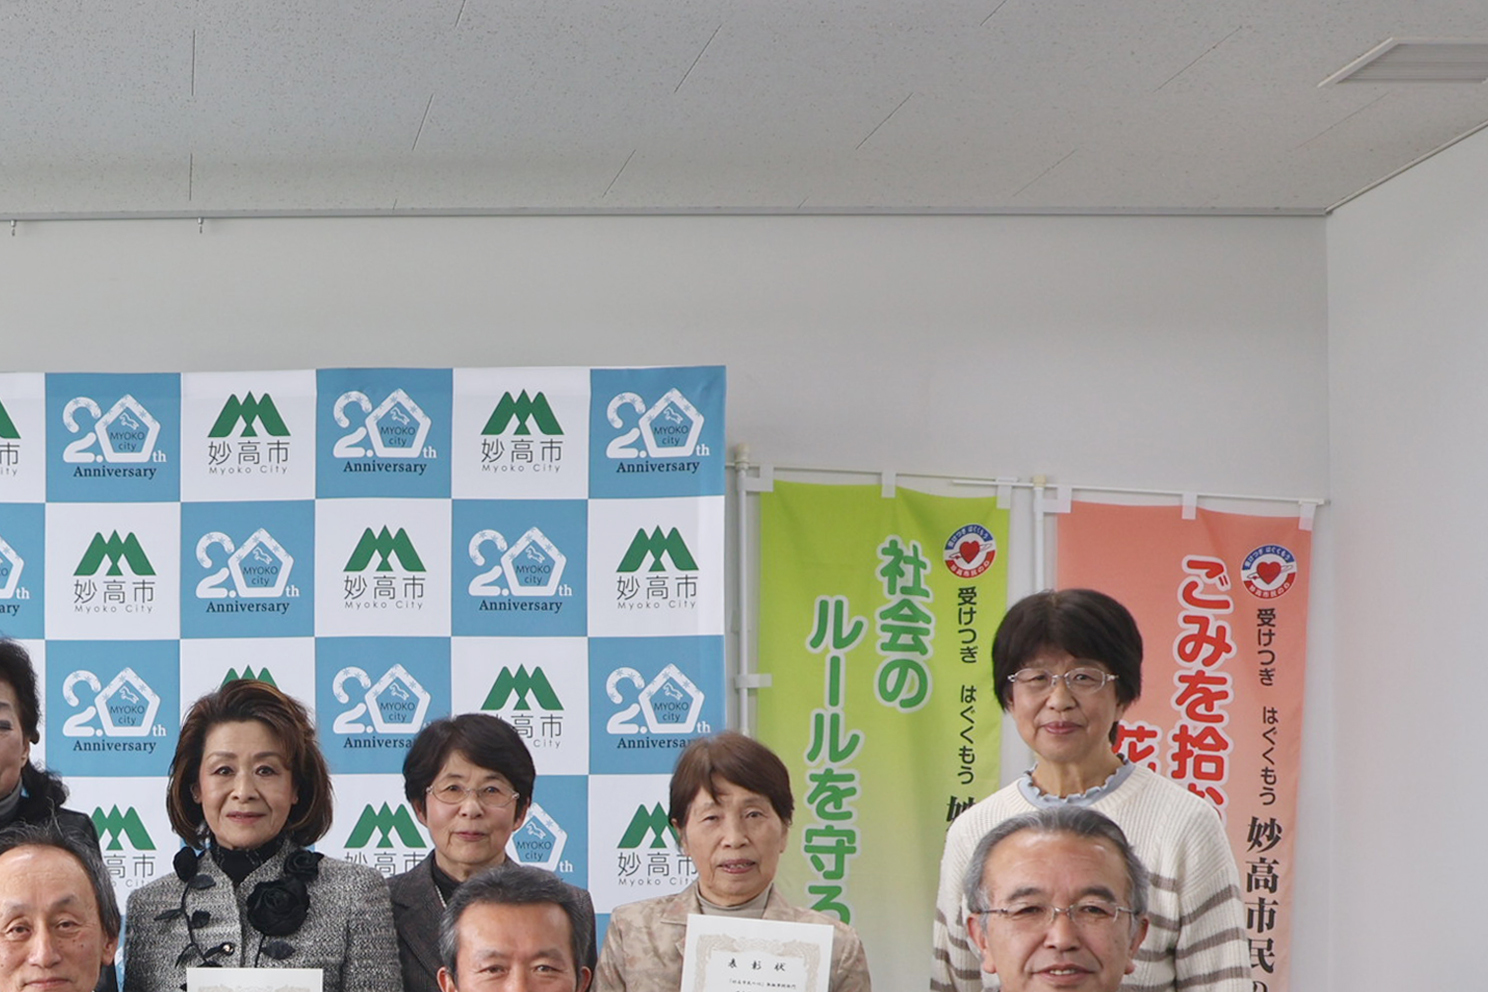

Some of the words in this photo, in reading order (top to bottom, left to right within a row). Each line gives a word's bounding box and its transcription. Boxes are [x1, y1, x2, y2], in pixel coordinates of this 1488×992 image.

[111, 431, 145, 440] MYOKO
[381, 426, 415, 435] MYOKO
[654, 426, 688, 435] MYOKO
[118, 441, 137, 451] city
[388, 436, 407, 446] city
[661, 436, 680, 446] city
[208, 440, 290, 465] 妙高市
[481, 438, 563, 463] 妙高市
[73, 464, 157, 480] Anniversary
[208, 465, 252, 475] Myoko
[259, 464, 288, 475] City
[343, 459, 427, 475] Anniversary
[481, 463, 525, 473] Myoko
[532, 462, 561, 473] City
[616, 459, 700, 475] Anniversary
[244, 566, 278, 575] MYOKO
[516, 564, 550, 573] MYOKO
[251, 576, 270, 586] city
[523, 574, 542, 584] city
[73, 579, 155, 604] 妙高市
[344, 575, 426, 600] 妙高市
[616, 575, 698, 600] 妙高市
[73, 604, 117, 614] Myoko
[124, 603, 153, 614] City
[206, 599, 290, 615] Anniversary
[344, 600, 388, 610] Myoko
[395, 599, 424, 610] City
[478, 597, 562, 613] Anniversary
[616, 600, 660, 610] Myoko
[667, 599, 696, 610] City
[879, 538, 933, 709] 社会の
[957, 586, 978, 664] 受けつぎ
[1257, 608, 1276, 687] 受けつぎ
[110, 705, 144, 714] MYOKO
[380, 702, 415, 711] MYOKO
[654, 702, 689, 711] MYOKO
[117, 715, 136, 725] city
[388, 714, 407, 723] city
[662, 714, 681, 723] city
[496, 713, 563, 738] 高市
[957, 685, 978, 785] はぐくもう
[72, 738, 156, 754] Anniversary
[343, 736, 412, 748] Anniversa
[533, 739, 560, 749] City
[617, 737, 688, 749] Anniversa
[1259, 706, 1280, 806] はぐくもう
[517, 841, 552, 850] MYOKO
[525, 853, 543, 862] city
[104, 853, 155, 879] 高市
[126, 879, 148, 887] Cit
[618, 877, 661, 886] Myoko
[669, 876, 691, 885] Cit
